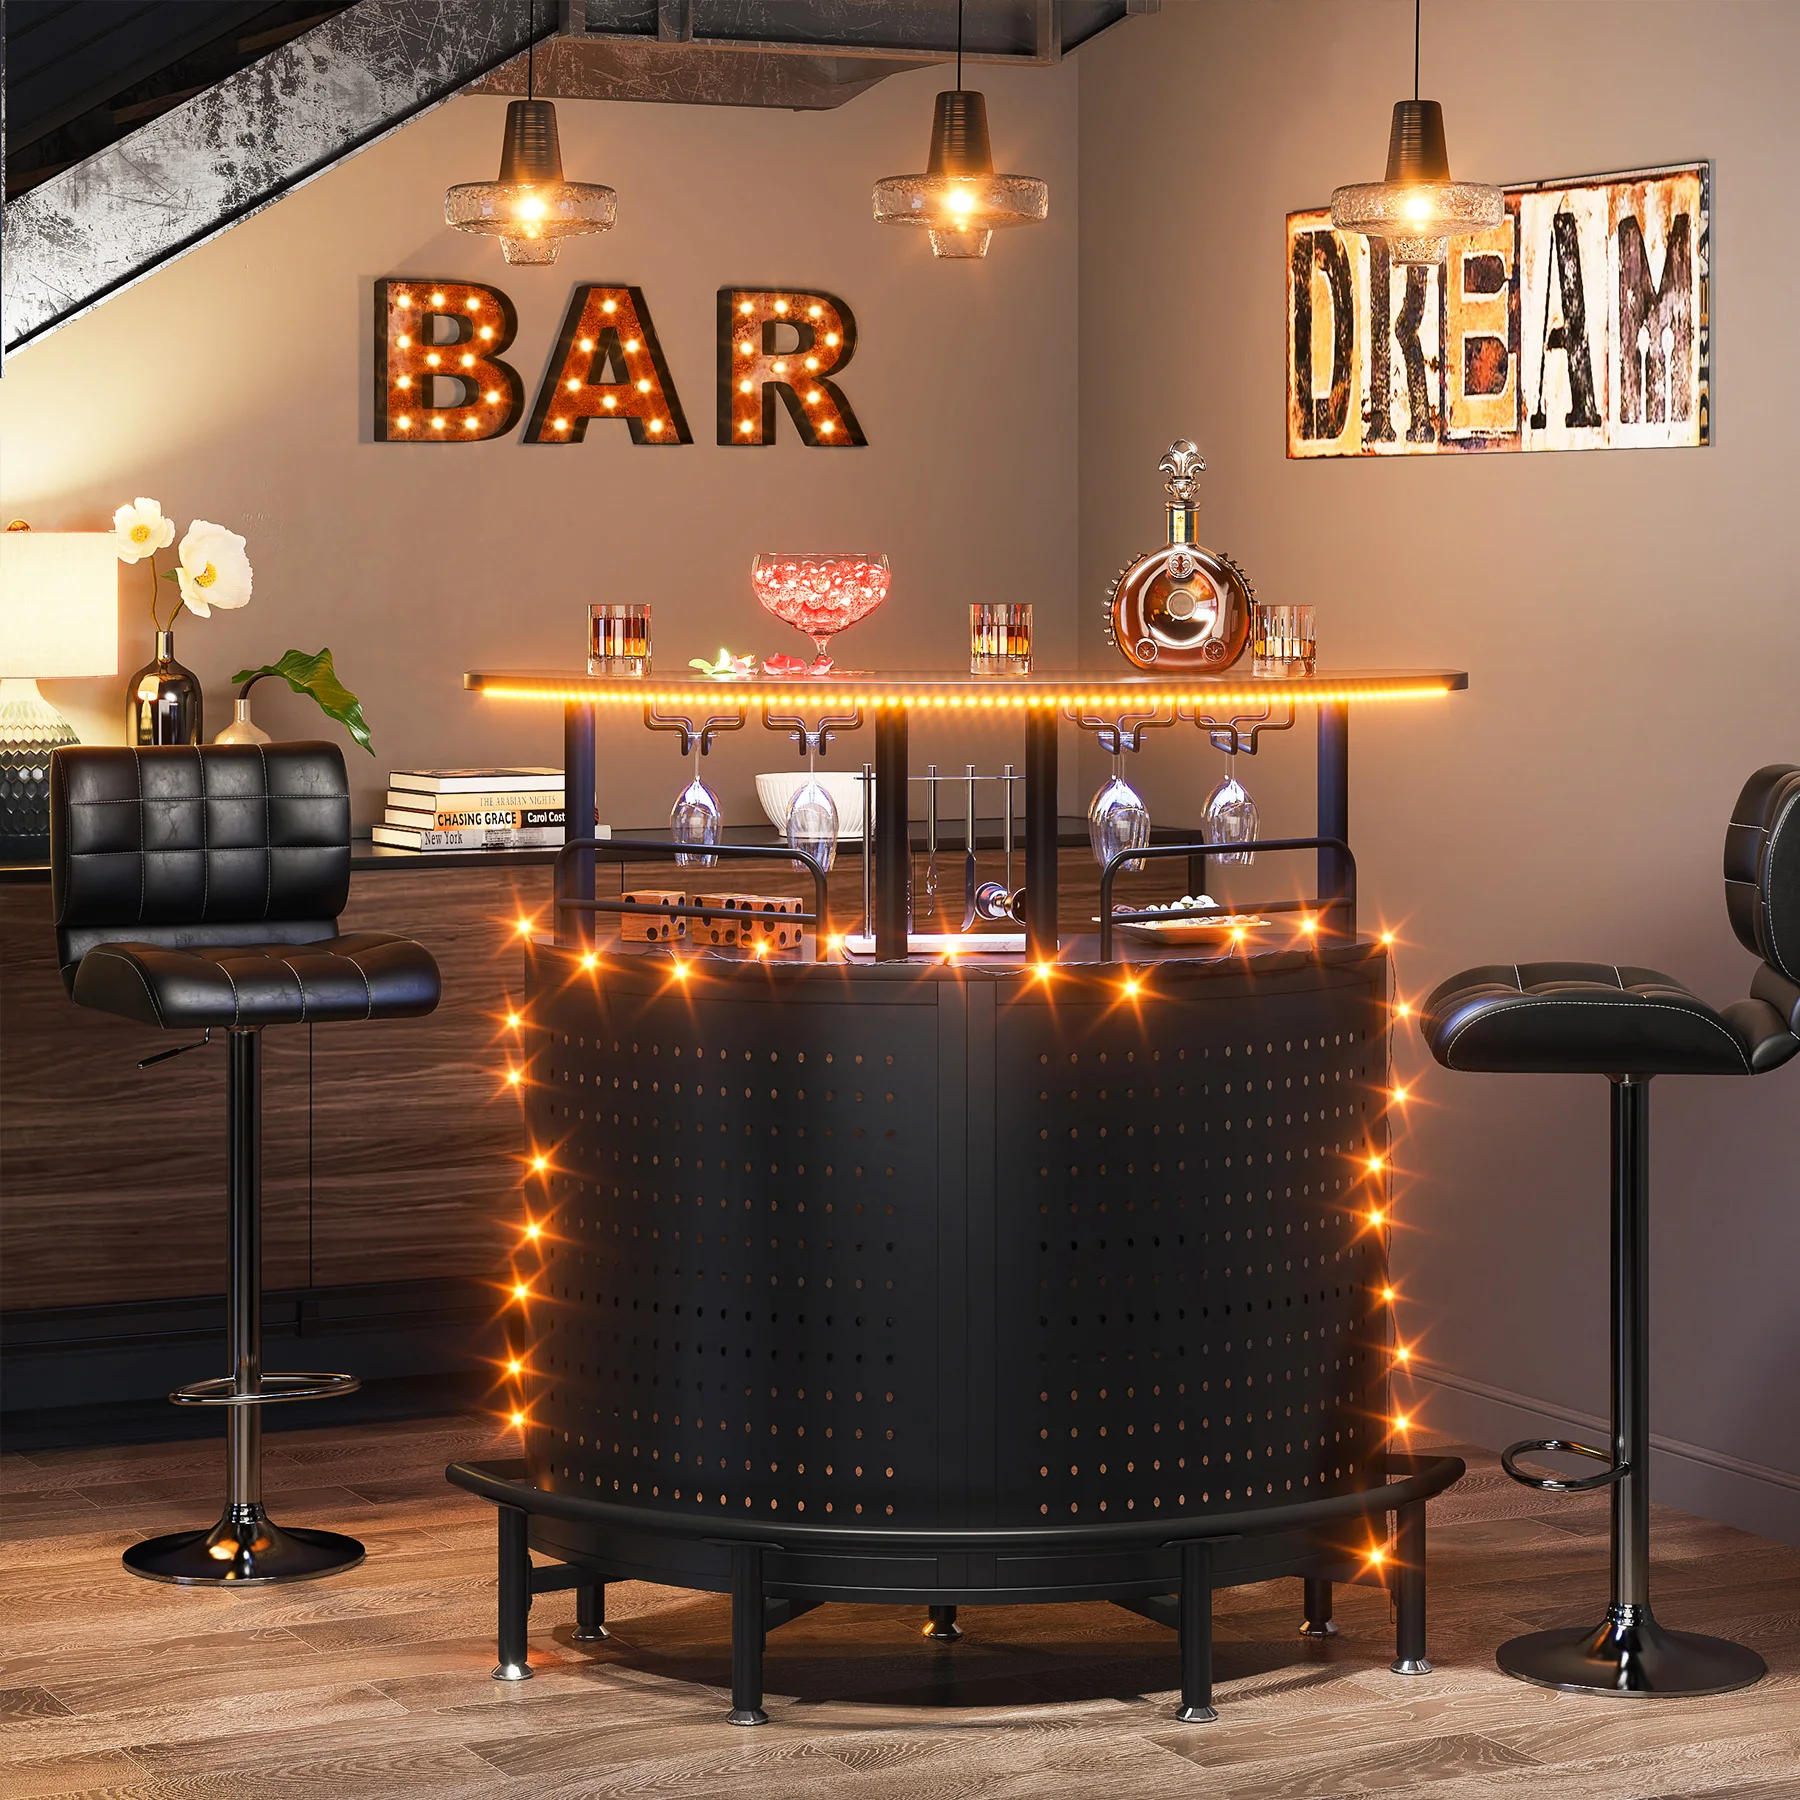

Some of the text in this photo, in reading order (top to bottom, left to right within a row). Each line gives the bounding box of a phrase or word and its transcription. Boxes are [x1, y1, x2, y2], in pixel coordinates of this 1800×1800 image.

[1292, 209, 1693, 443] DREAM
[374, 279, 870, 447] BAR
[480, 794, 556, 807] THE ARABIAN NIGHTS
[437, 811, 517, 827] CHASING GRACE
[527, 811, 548, 823] Carol
[424, 830, 463, 846] New York
